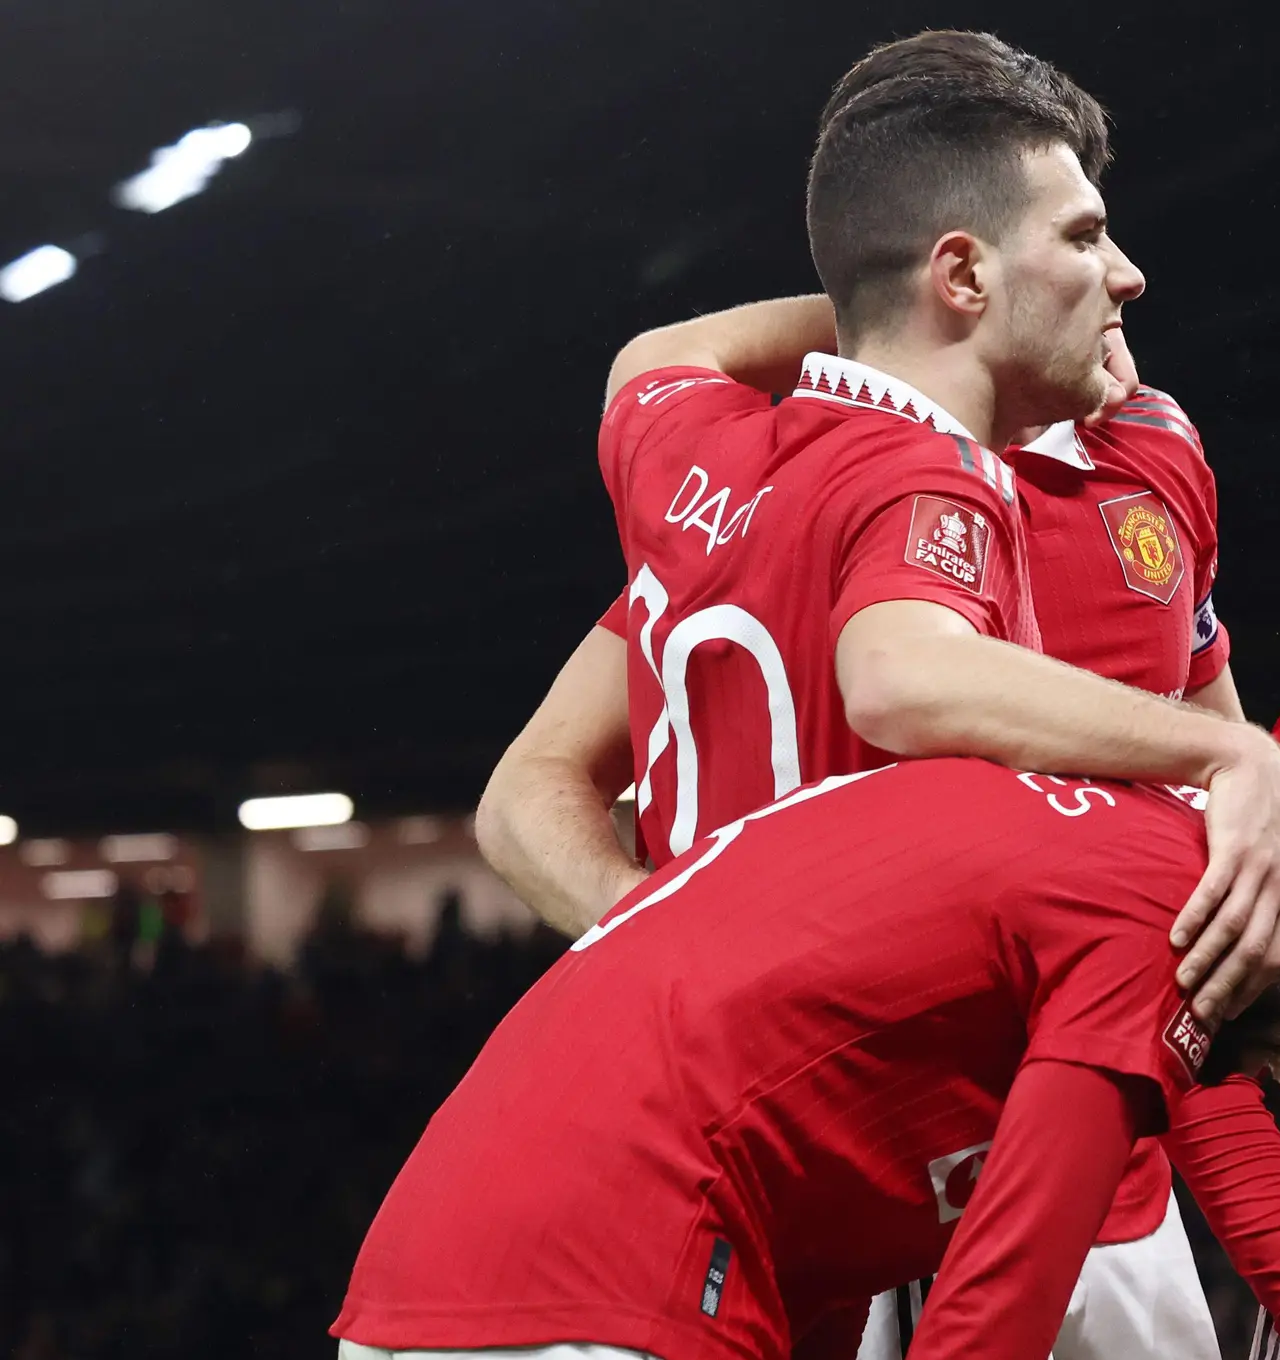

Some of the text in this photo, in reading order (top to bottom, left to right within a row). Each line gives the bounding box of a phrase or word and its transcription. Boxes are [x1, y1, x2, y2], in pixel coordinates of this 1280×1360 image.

[1124, 510, 1166, 541] MANCHESTER
[915, 549, 975, 582] FA CUP
[917, 538, 976, 575] Emirates
[1143, 562, 1173, 581] UNITED
